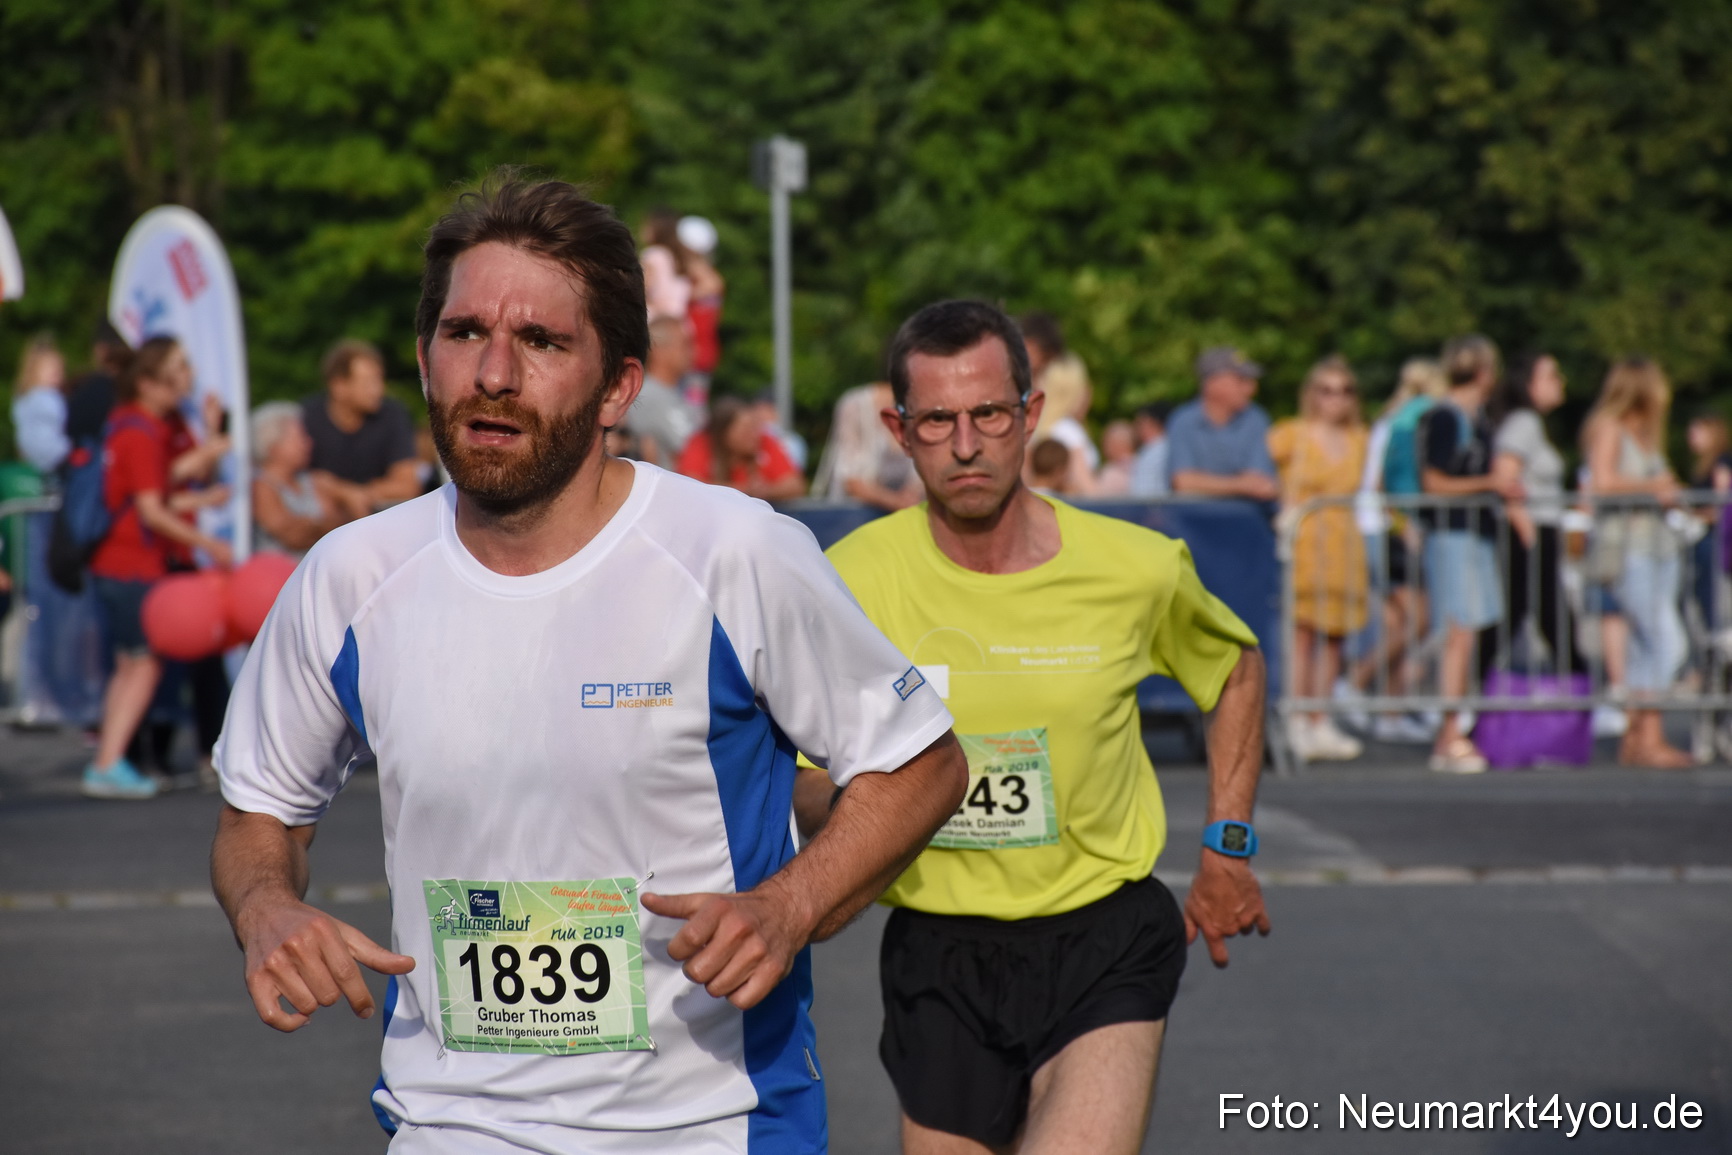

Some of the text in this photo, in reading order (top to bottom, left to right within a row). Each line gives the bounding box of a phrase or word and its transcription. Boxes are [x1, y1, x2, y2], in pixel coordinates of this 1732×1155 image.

[617, 682, 673, 697] PETTER
[616, 698, 673, 708] INGENIEURE
[957, 775, 1030, 816] 43
[977, 818, 1025, 828] Damian
[550, 886, 623, 901] Gesunde Firmen
[459, 914, 531, 931] firmenlauf
[551, 925, 624, 941] run 2019
[459, 943, 611, 1005] 1839
[477, 1007, 596, 1023] Gruber Thomas
[477, 1025, 599, 1039] Petter Ingenieure GmbH
